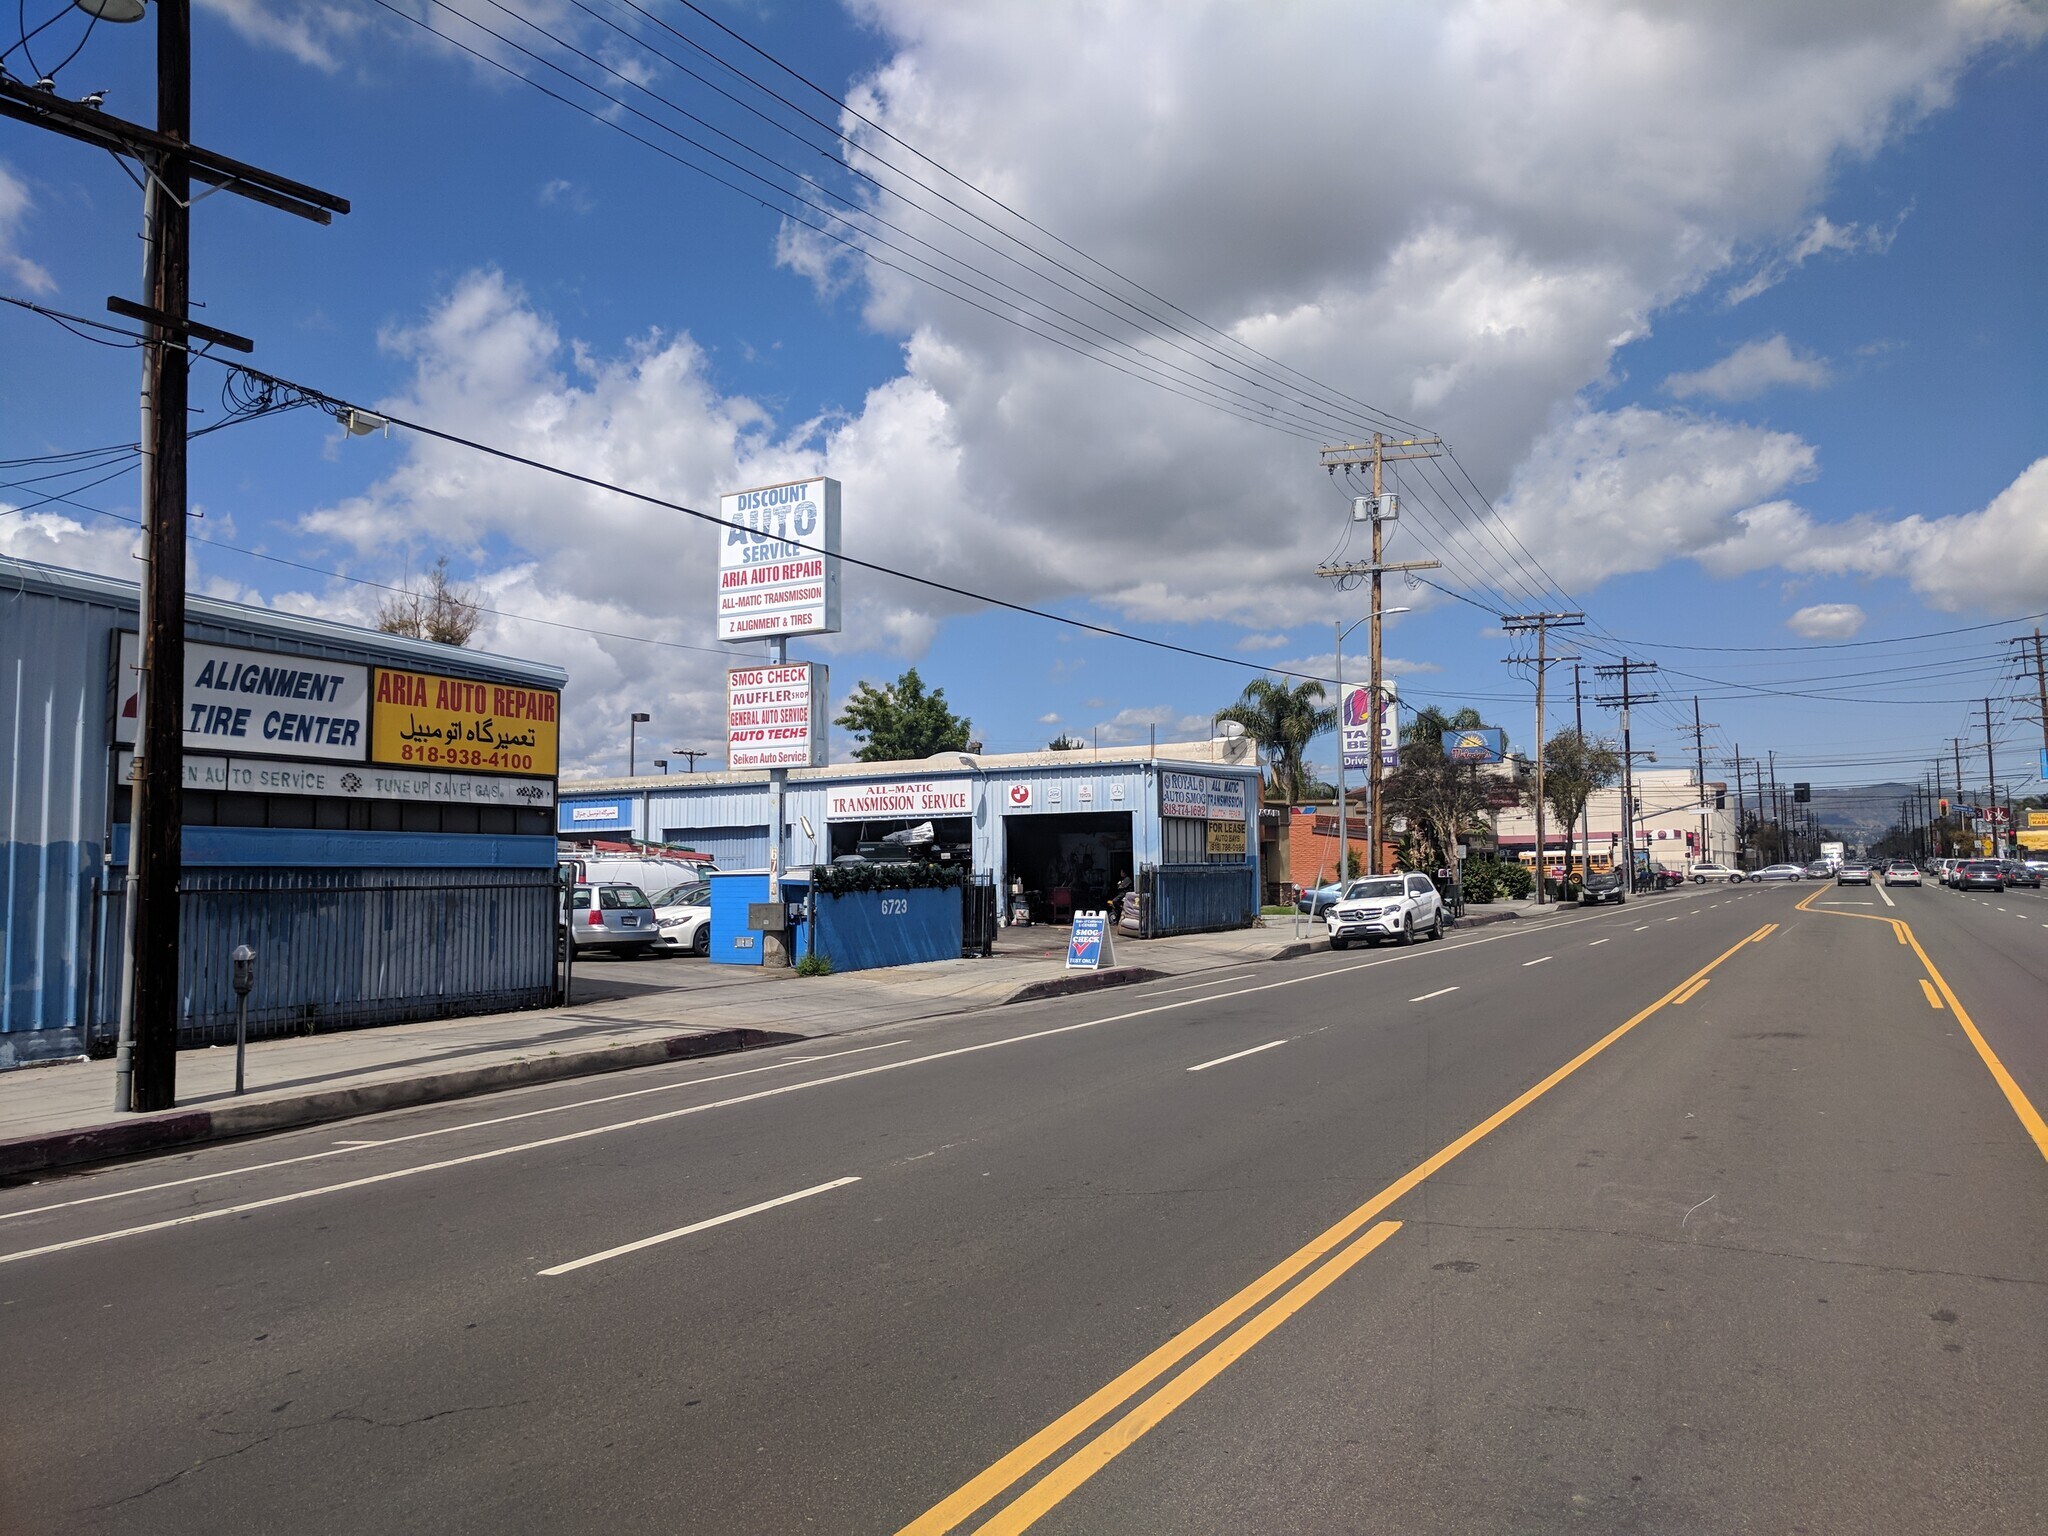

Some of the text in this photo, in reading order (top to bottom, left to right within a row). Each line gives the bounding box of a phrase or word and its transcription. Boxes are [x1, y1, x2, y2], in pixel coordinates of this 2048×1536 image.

[738, 484, 808, 511] DISCOUNT
[727, 501, 817, 546] AUTO
[742, 540, 800, 563] SERVICE
[722, 560, 822, 588] ARIA AUTO REPAIR
[722, 587, 822, 609] ALL-MATIC TRANSMISSION
[730, 613, 813, 632] Z ALIGNMENT & TIRES
[194, 659, 344, 703] ALIGNMENT
[731, 668, 806, 686] SMOG CHECK
[377, 672, 556, 723] ARIA AUTO REPAIR
[733, 690, 808, 705] MUFFLER SHOP
[190, 703, 361, 747] TIRE CENTER
[730, 707, 808, 726] GENERAL AUTO SERVICE
[400, 713, 535, 749] تعمیرگاه اتومبیل
[731, 727, 808, 742] AUTO TECHS
[1343, 729, 1392, 739] TAO
[1346, 738, 1393, 750] BEL
[401, 744, 533, 770] 818-938-4100
[733, 751, 807, 765] Seiken Auto Service
[866, 784, 933, 795] ALL-MATIC
[1172, 774, 1198, 790] ROYAL
[1212, 780, 1239, 793] ALL MATIC
[833, 793, 966, 813] TRANSMISSION SERVICE
[1163, 791, 1206, 804] AUTO SMOG
[1207, 794, 1244, 808] TRANSMISSION
[1163, 803, 1206, 817] 818-774-1692
[1208, 822, 1246, 834] FOR LEASE
[1215, 834, 1228, 842] AUTO
[881, 898, 908, 915] 6723
